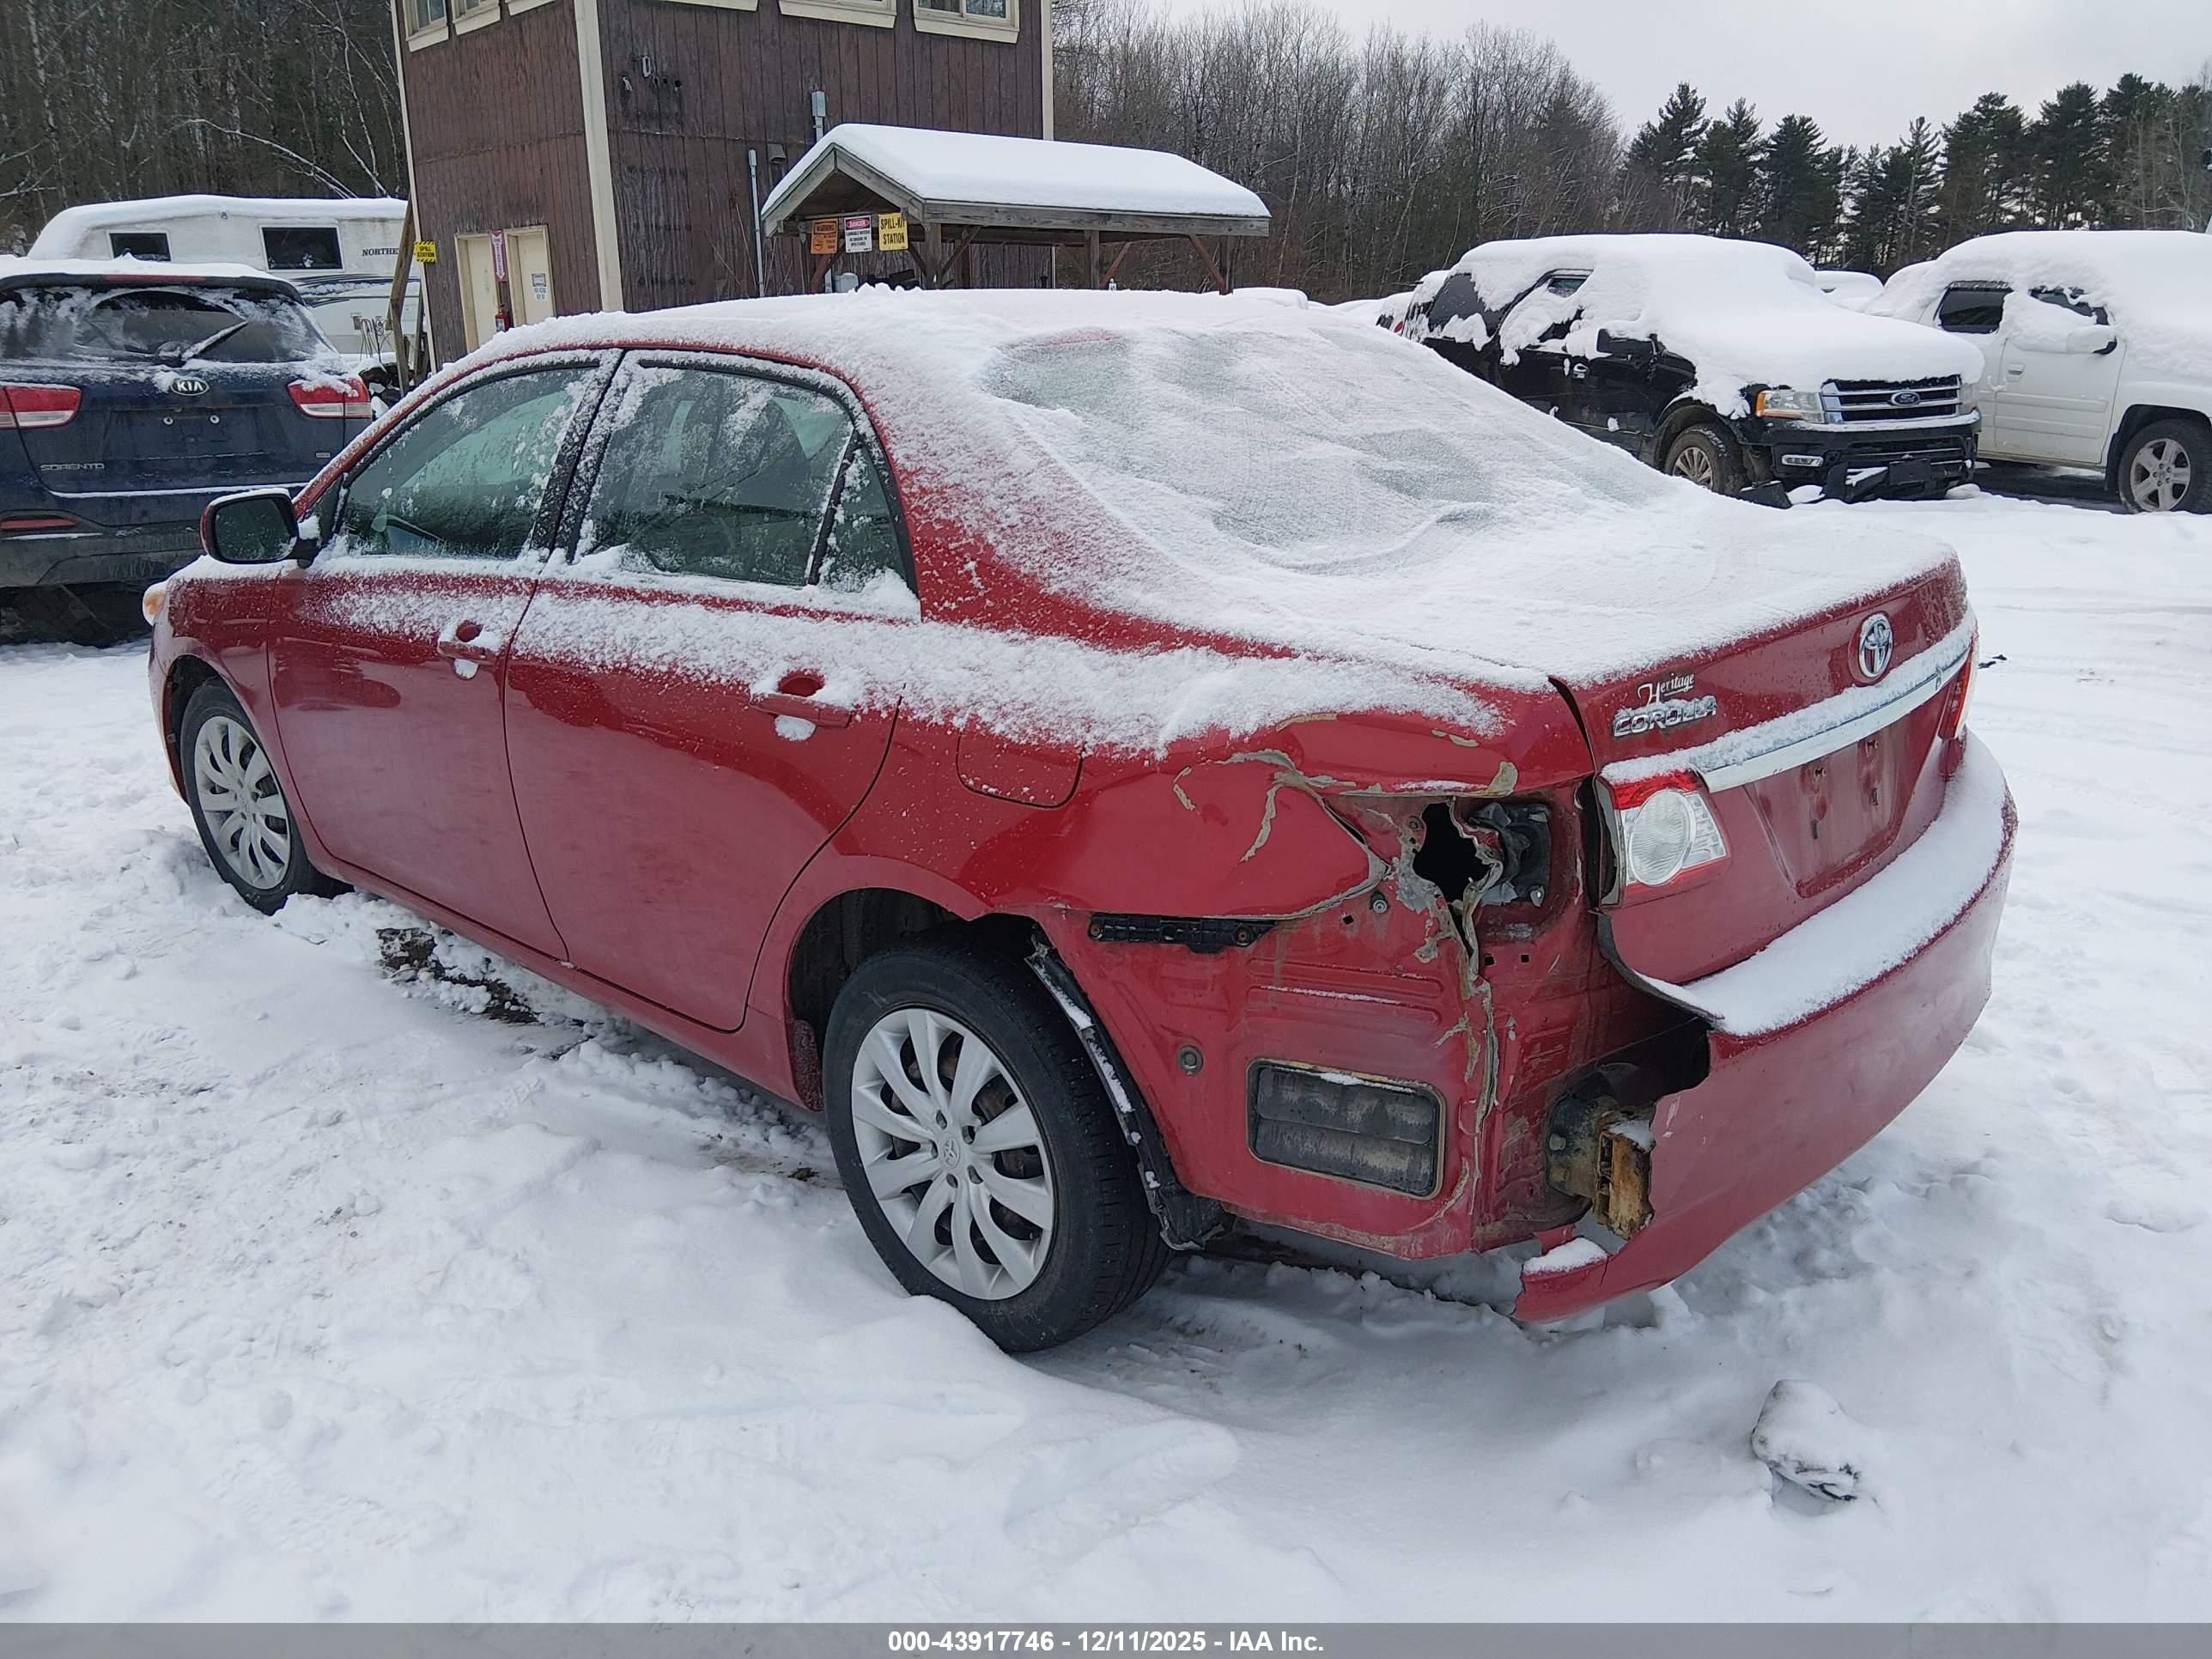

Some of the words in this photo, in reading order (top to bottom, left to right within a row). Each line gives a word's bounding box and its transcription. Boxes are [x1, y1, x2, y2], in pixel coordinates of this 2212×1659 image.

[883, 232, 905, 245] STATION
[177, 380, 204, 392] KIA
[1637, 672, 1695, 706] Heritage
[1613, 698, 1717, 737] COROLLA
